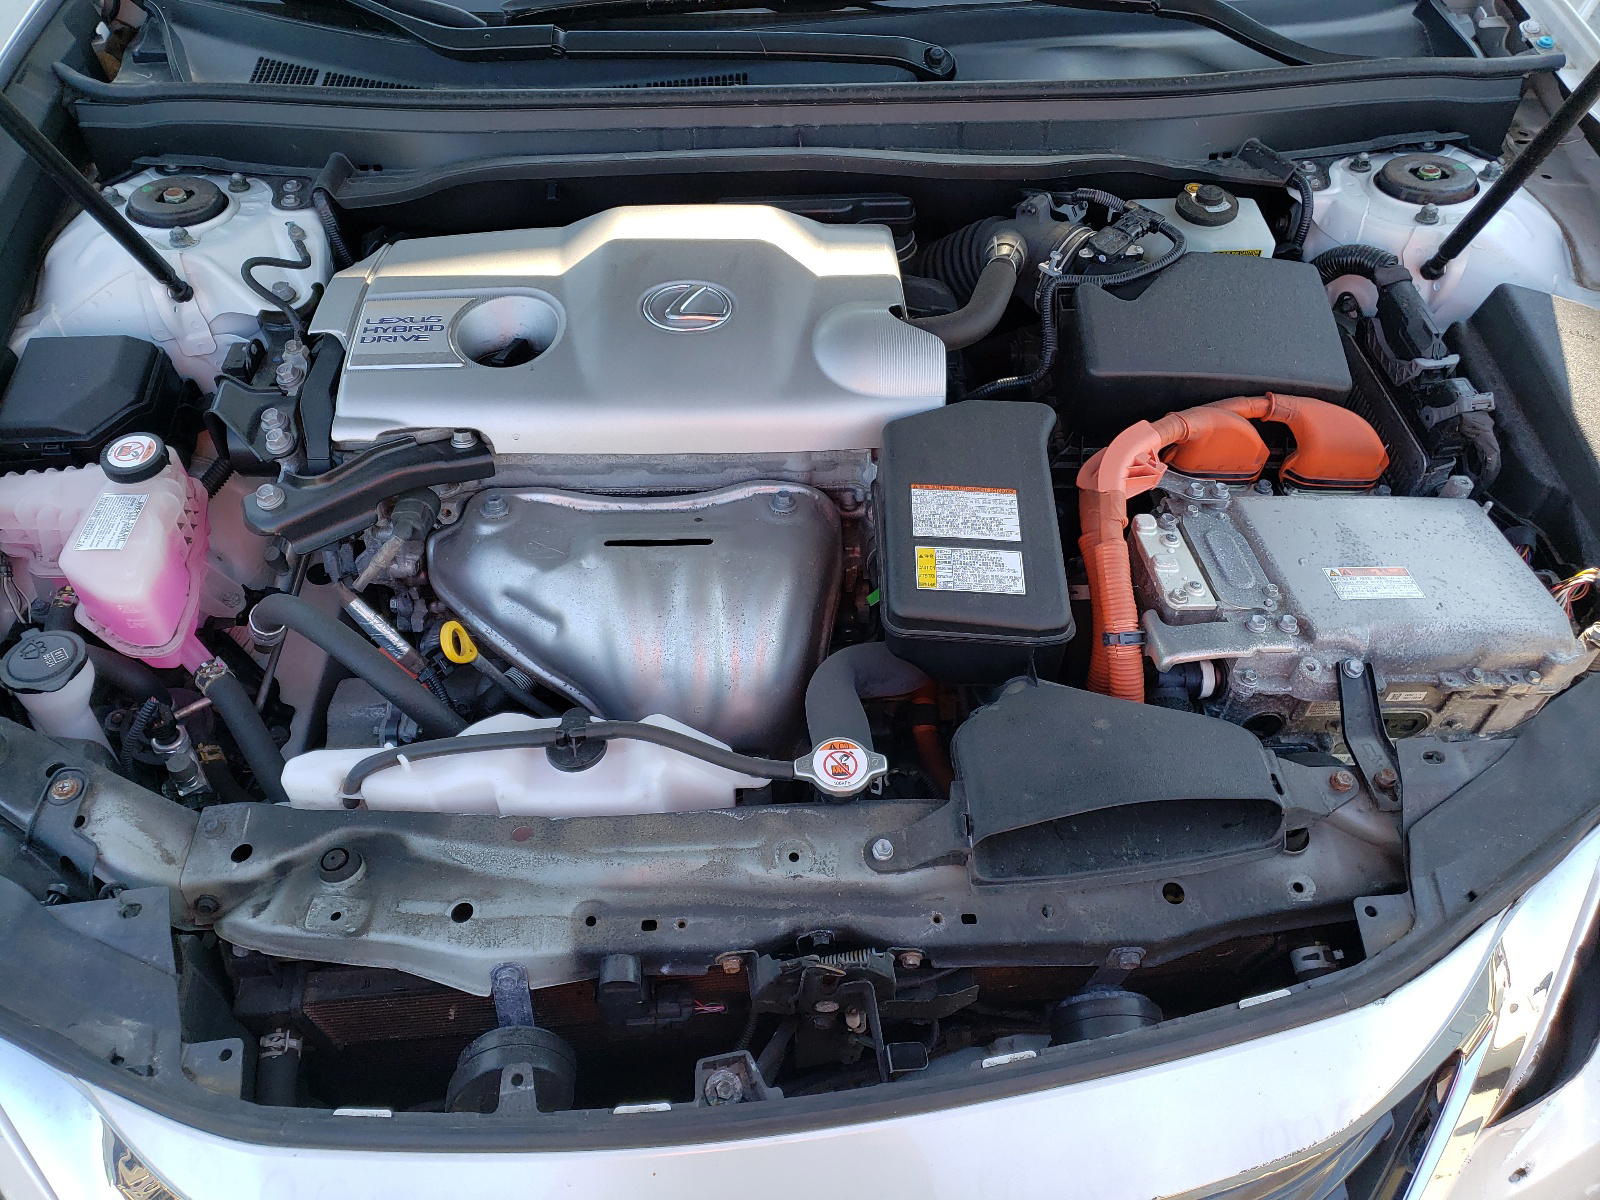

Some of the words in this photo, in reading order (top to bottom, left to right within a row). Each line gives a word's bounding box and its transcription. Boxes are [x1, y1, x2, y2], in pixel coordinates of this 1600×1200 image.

[366, 315, 442, 324] LEXUS
[363, 324, 445, 334] HYBRID
[360, 334, 430, 344] DRIVE
